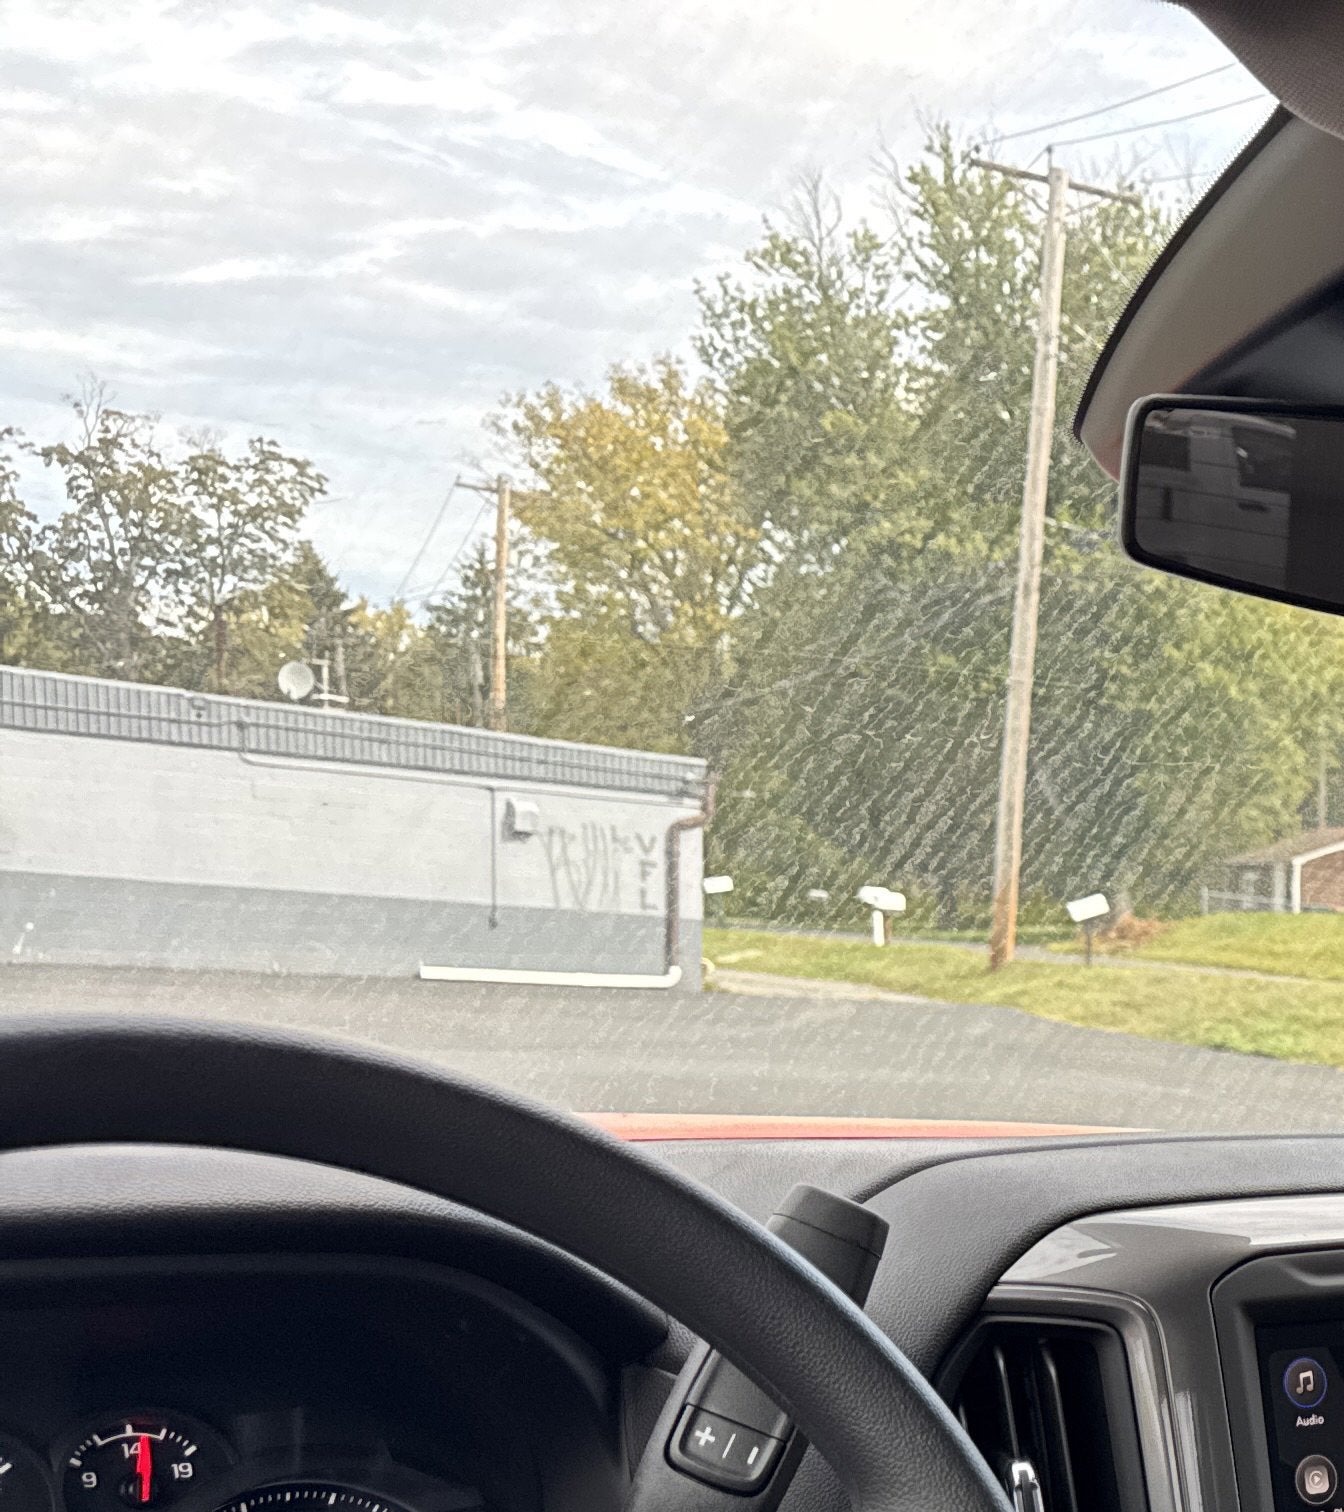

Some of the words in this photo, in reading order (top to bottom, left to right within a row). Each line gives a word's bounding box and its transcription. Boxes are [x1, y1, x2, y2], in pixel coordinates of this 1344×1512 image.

[1296, 1414, 1325, 1427] Audio
[121, 1442, 141, 1459] 14
[171, 1462, 194, 1480] 19
[81, 1471, 98, 1489] 9
